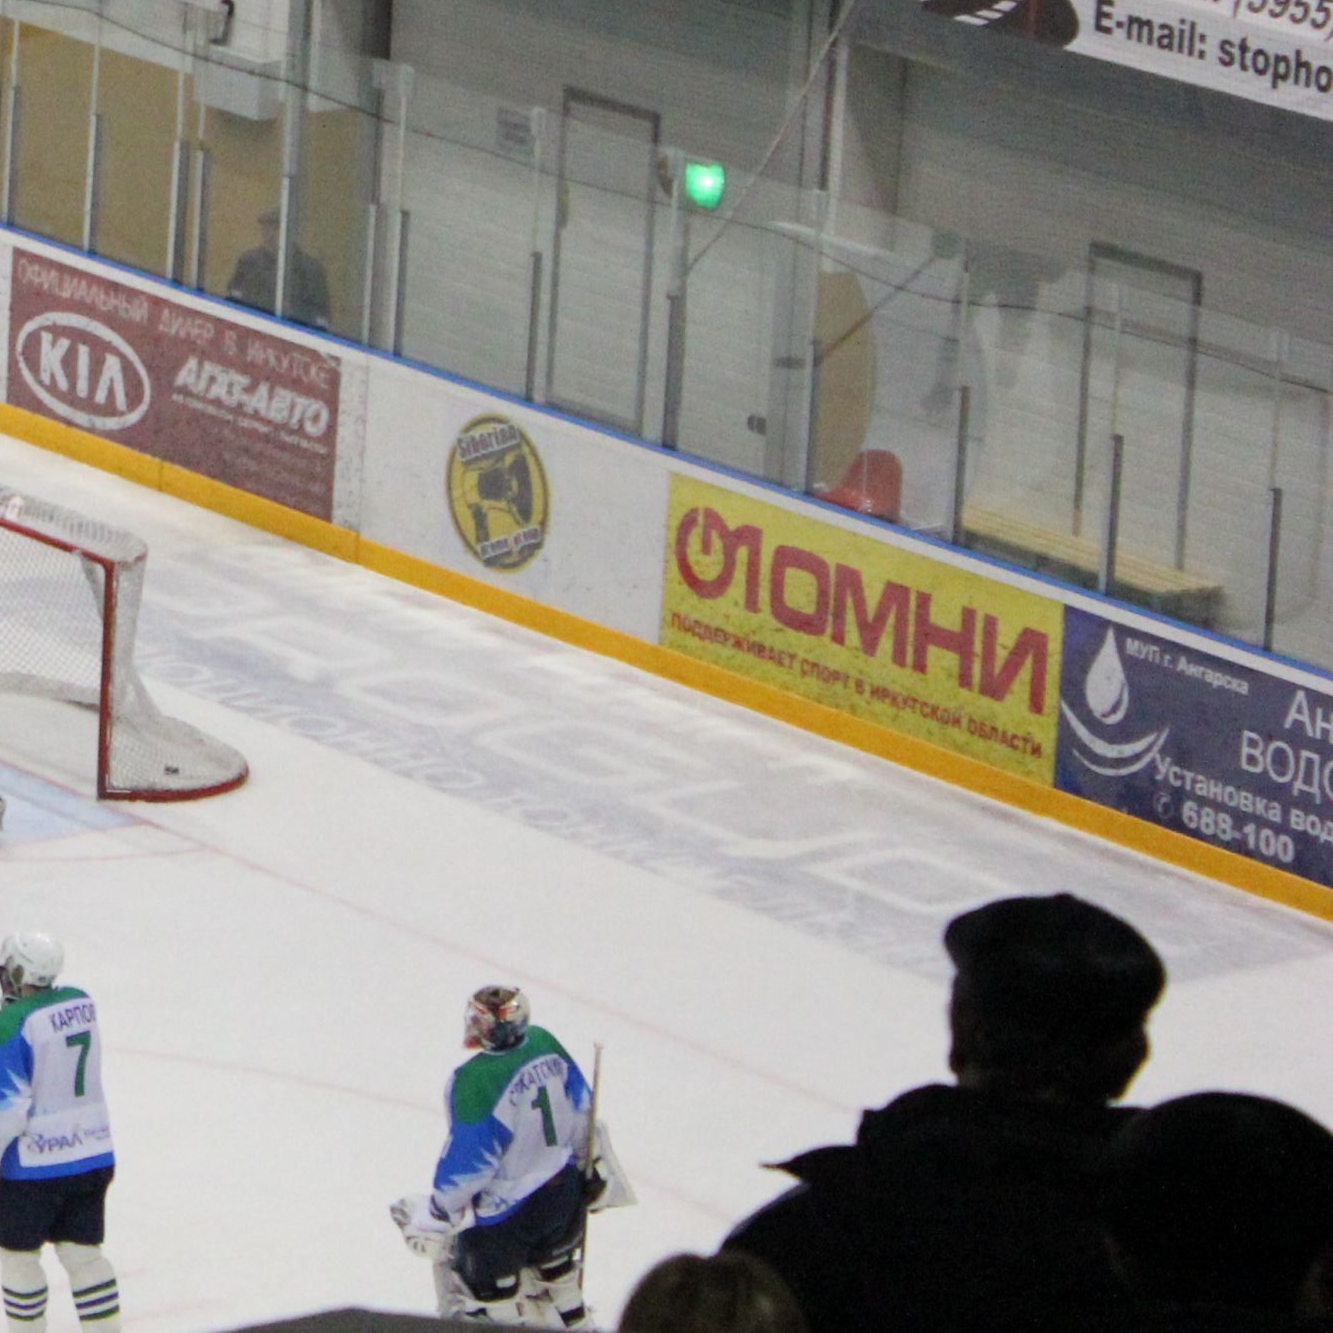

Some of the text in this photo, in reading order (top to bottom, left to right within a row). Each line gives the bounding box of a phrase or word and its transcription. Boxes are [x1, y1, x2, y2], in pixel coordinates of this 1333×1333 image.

[39, 330, 128, 413] KIA
[800, 658, 850, 690] СПОРТ
[967, 719, 1043, 759] ОБЛАСТИ
[1153, 753, 1282, 825] Установка
[1182, 800, 1296, 864] 688-100
[65, 1029, 92, 1099] 7
[531, 1086, 559, 1147] 1
